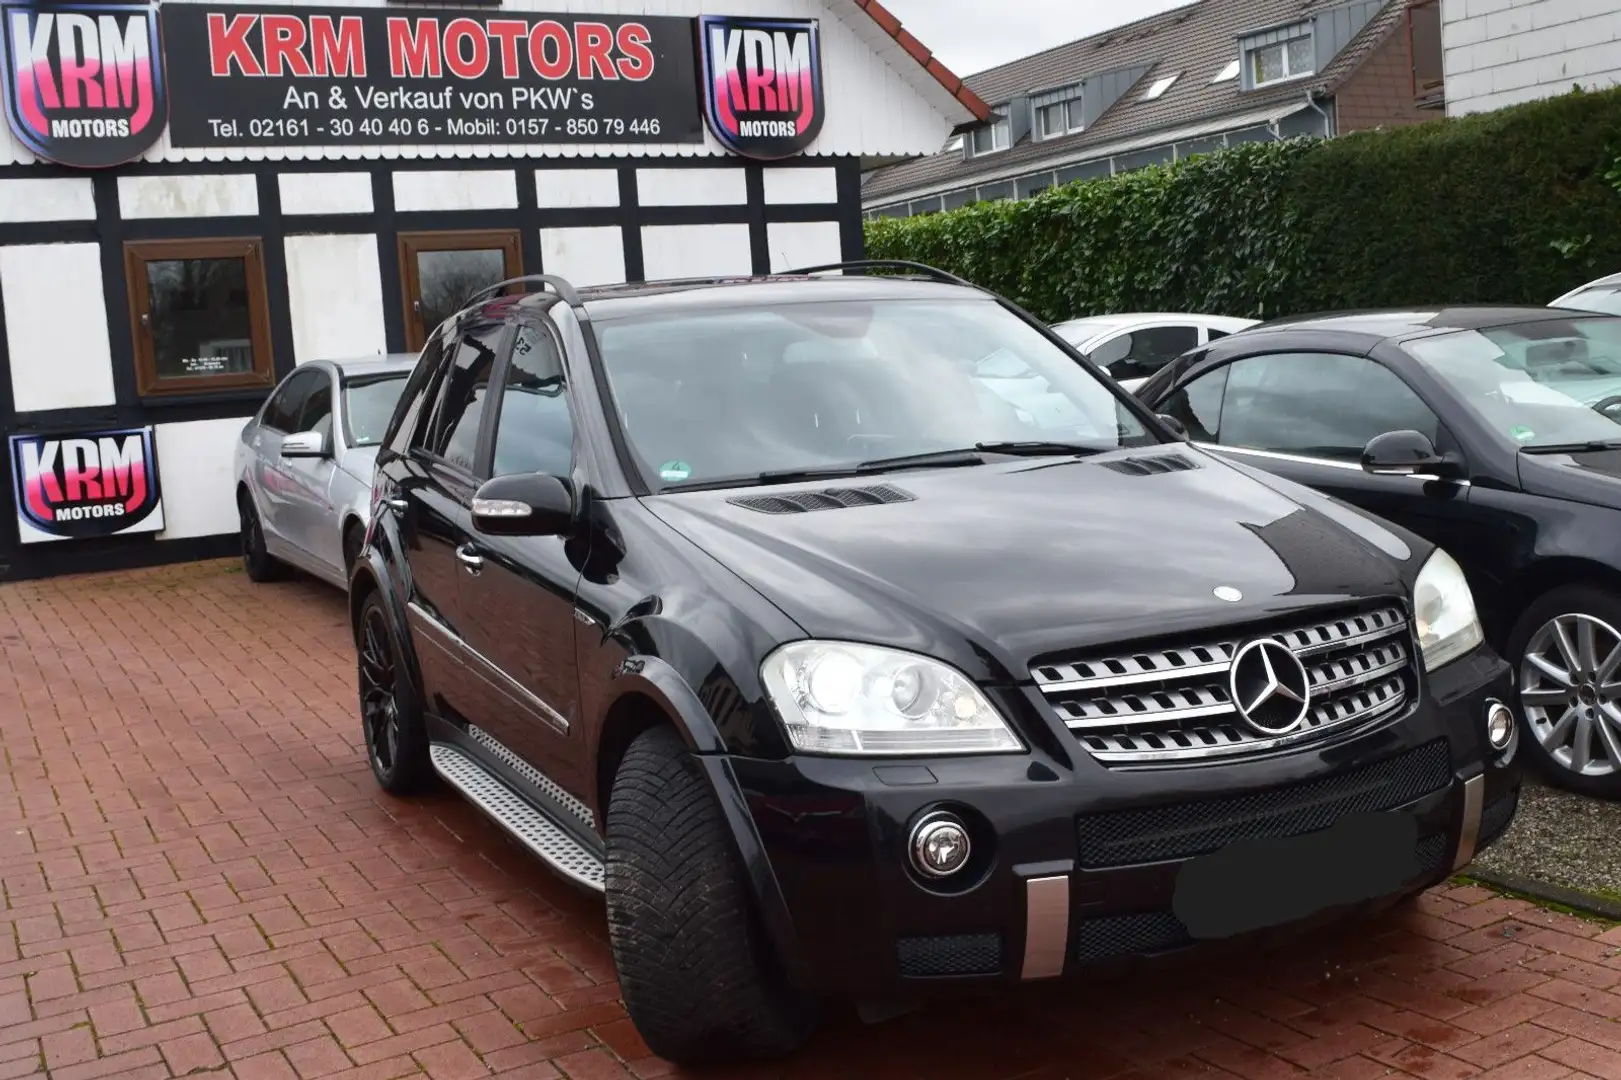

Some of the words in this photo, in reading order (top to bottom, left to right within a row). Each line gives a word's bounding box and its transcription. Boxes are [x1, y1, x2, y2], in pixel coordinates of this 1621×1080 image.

[207, 13, 367, 78] KRM
[386, 17, 655, 81] MOTORS
[11, 12, 154, 137] KRM
[711, 28, 813, 137] KRM
[283, 86, 319, 109] An
[328, 86, 348, 109] &
[354, 86, 453, 109] Verkauf
[459, 92, 503, 109] von
[52, 118, 129, 138] MOTORS
[208, 119, 243, 137] Tel.
[250, 119, 309, 136] 02161
[330, 118, 353, 136] 30
[359, 118, 383, 136] 40
[388, 118, 412, 136] 40
[417, 118, 429, 136] 6
[447, 118, 500, 136] Mobil:
[506, 118, 549, 136] 0157
[567, 118, 598, 135] 850
[603, 118, 624, 135] 79
[629, 118, 660, 135] 446
[740, 120, 796, 137] MOTORS
[21, 435, 147, 521] KRM
[55, 502, 125, 521] MOTORS
